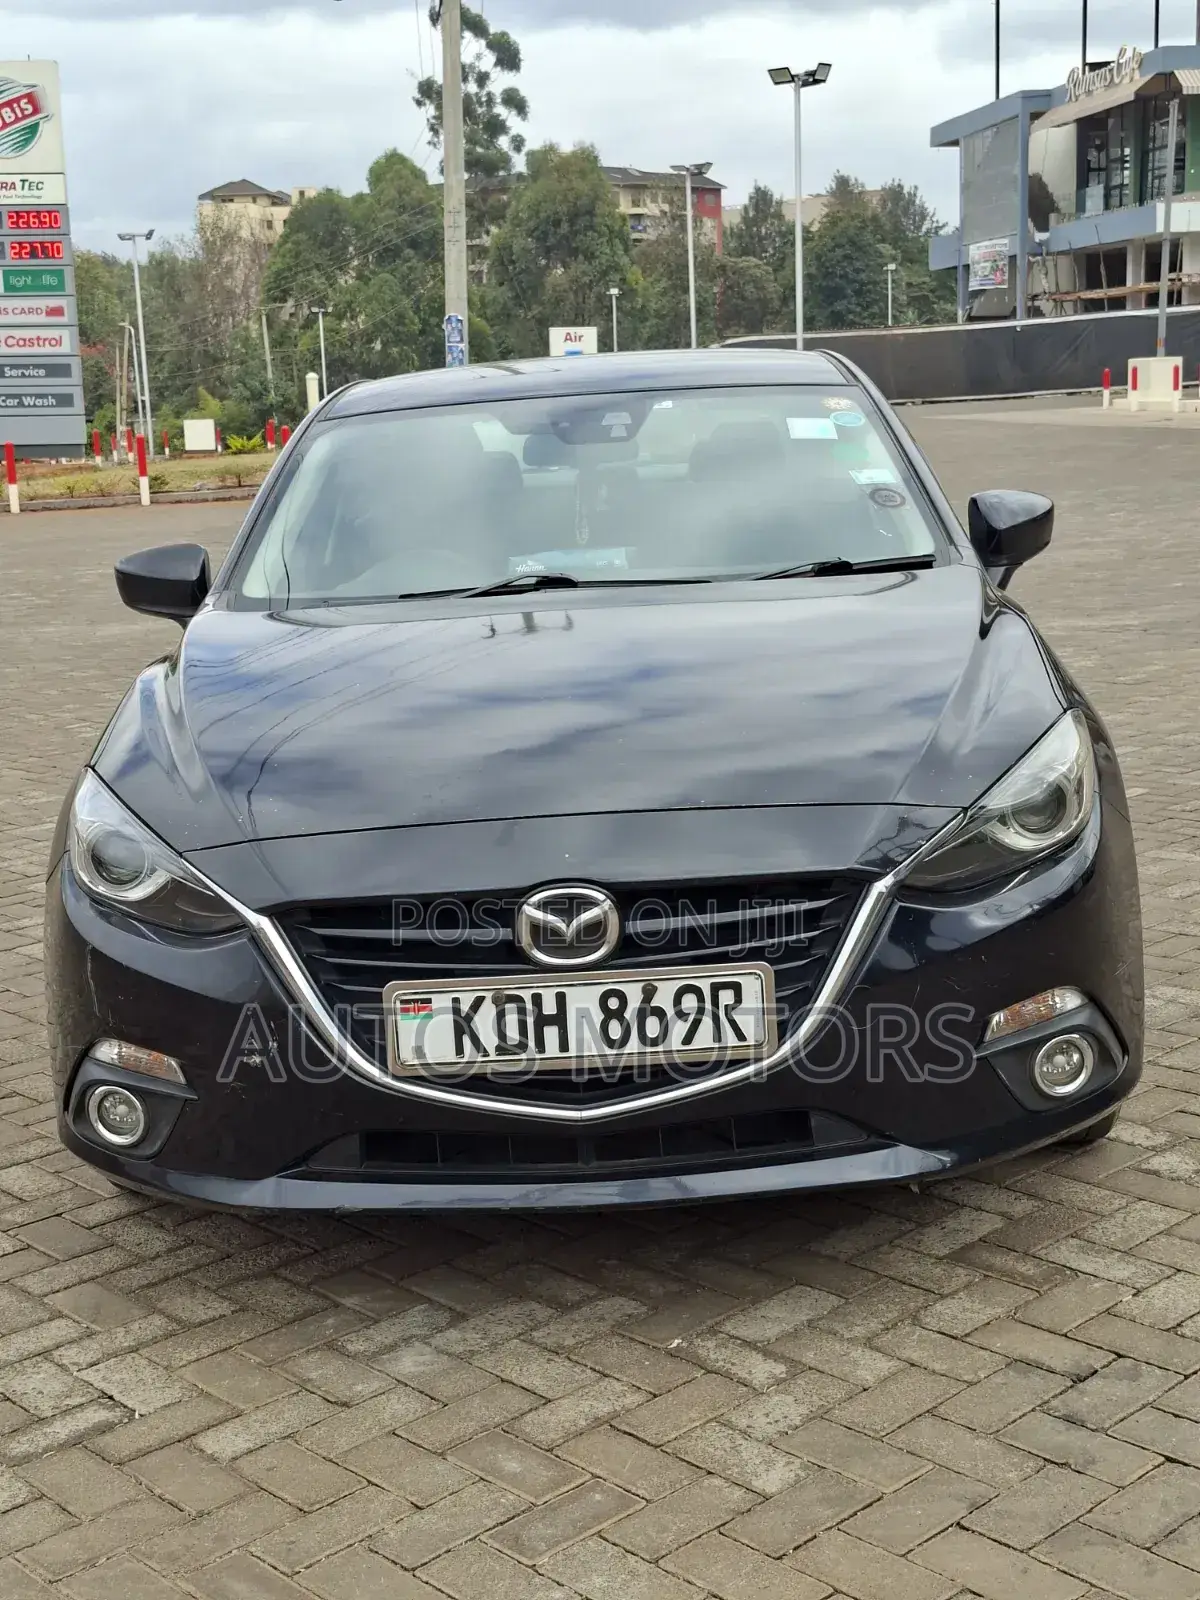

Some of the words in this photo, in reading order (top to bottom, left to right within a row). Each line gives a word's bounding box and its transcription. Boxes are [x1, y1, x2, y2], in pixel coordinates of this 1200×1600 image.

[8, 212, 61, 228] 226.90
[10, 243, 63, 258] 227.70
[12, 307, 43, 316] CARD
[4, 335, 62, 348] Castrol
[563, 331, 584, 343] Air
[4, 366, 46, 377] Service
[0, 396, 19, 406] Car
[22, 395, 56, 406] Wash
[452, 990, 569, 1058] KDH
[599, 980, 748, 1050] 869R
